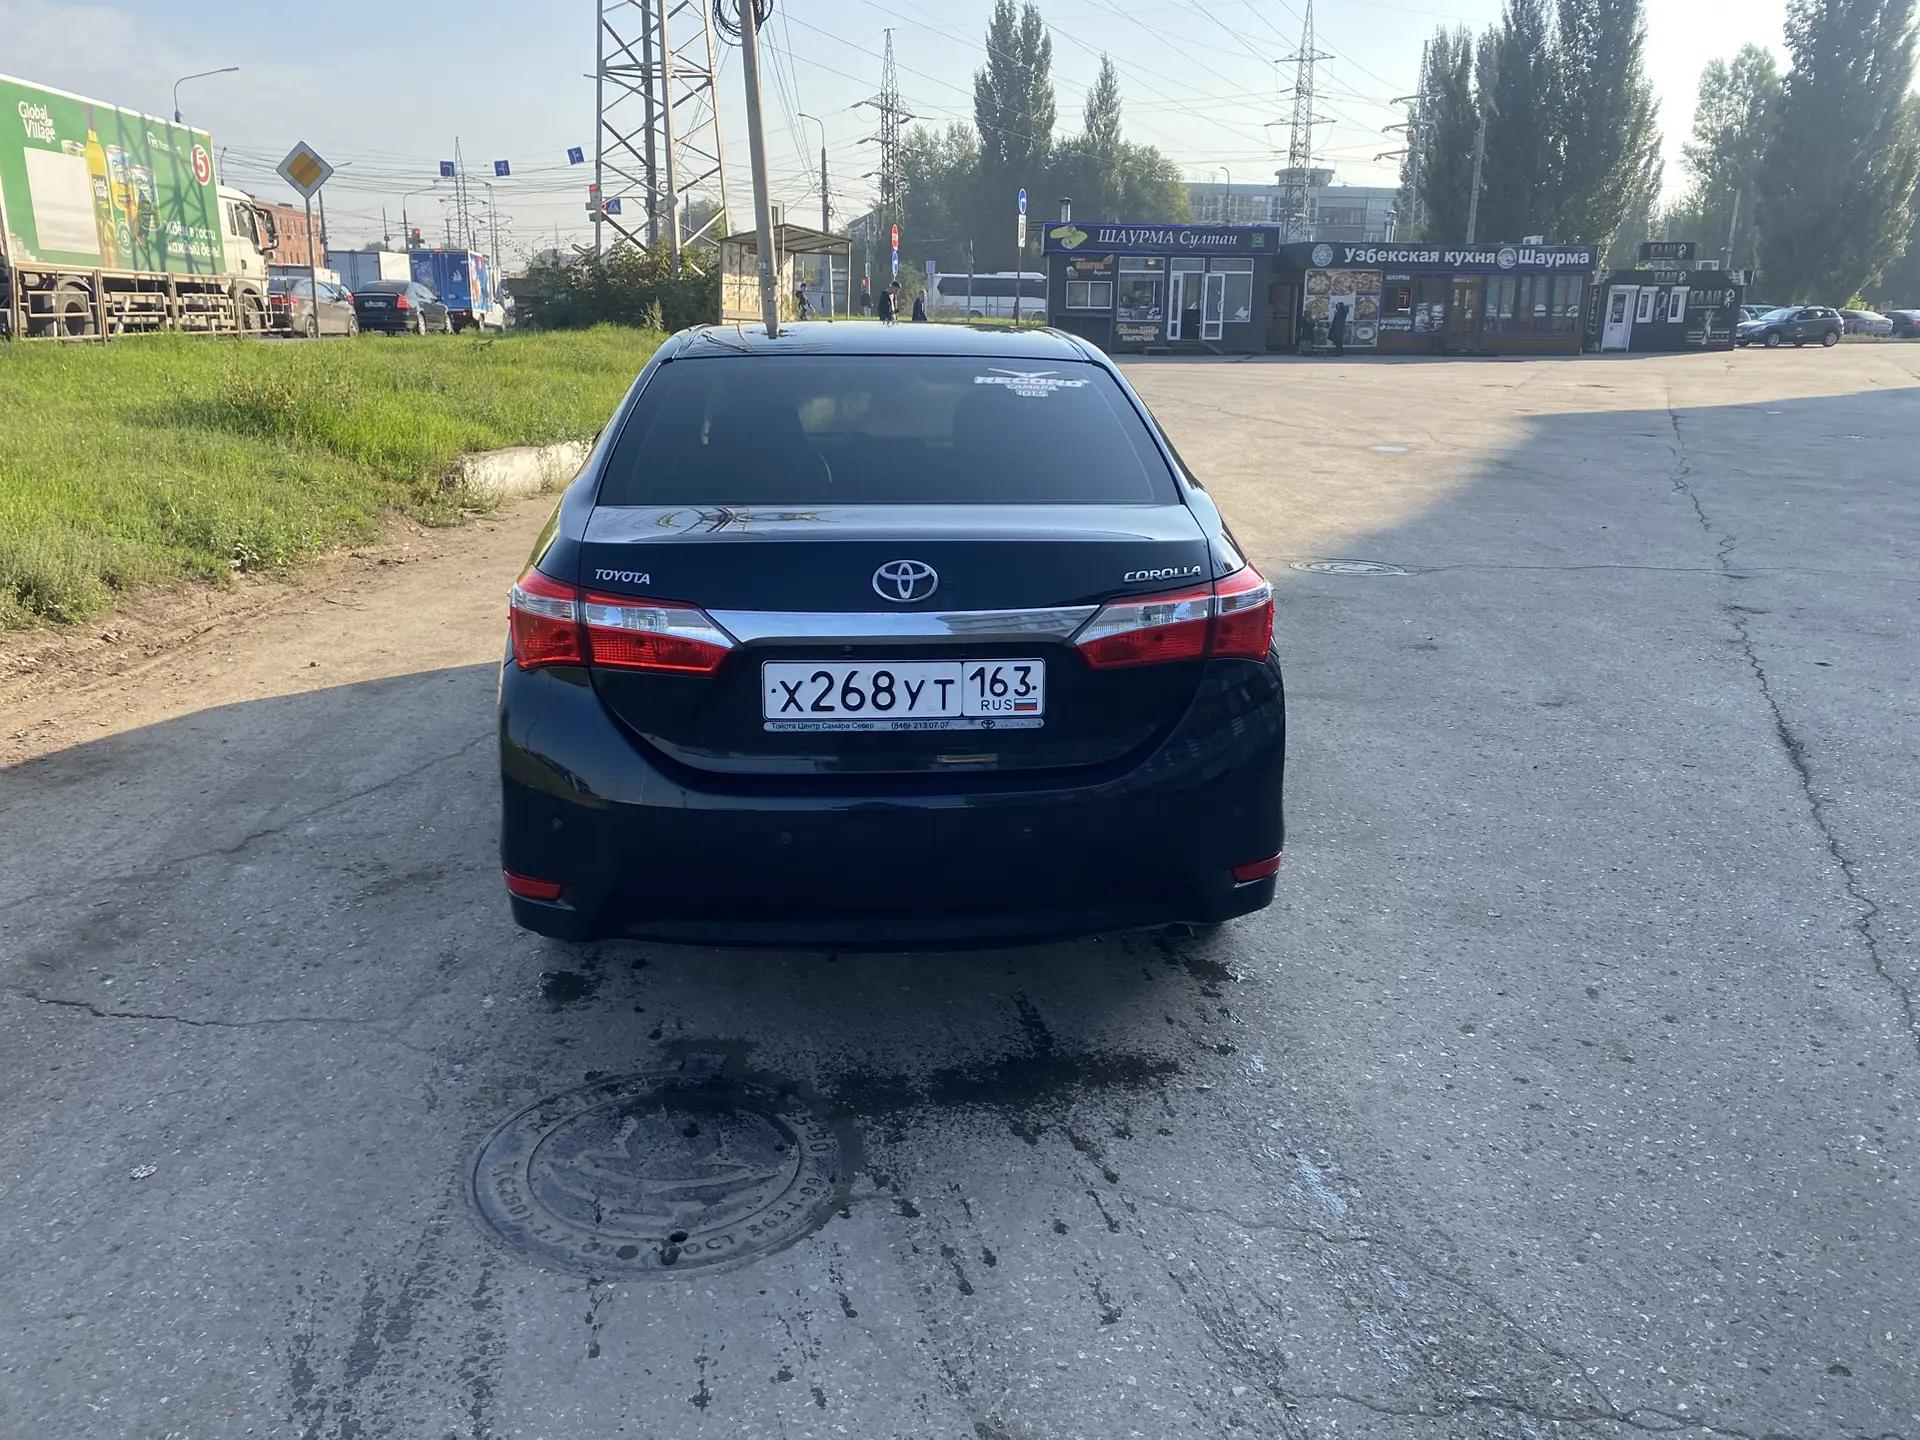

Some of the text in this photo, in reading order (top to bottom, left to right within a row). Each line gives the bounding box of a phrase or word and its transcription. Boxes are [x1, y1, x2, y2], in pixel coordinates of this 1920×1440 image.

[18, 101, 48, 120] Global
[23, 118, 56, 143] Village
[196, 147, 207, 178] 5
[1098, 229, 1237, 248] ШАУРМА Султан
[1344, 247, 1440, 264] Узбекская
[1444, 251, 1496, 266] кухня
[1518, 249, 1589, 268] Шаурма
[595, 569, 650, 584] TOYOTA
[1123, 565, 1201, 582] COROLLA
[969, 666, 1031, 697] 163
[980, 699, 1013, 711] RUS
[771, 722, 796, 730] Тойота
[797, 722, 820, 730] Центр
[821, 722, 849, 730] Самара
[851, 721, 874, 730] Север
